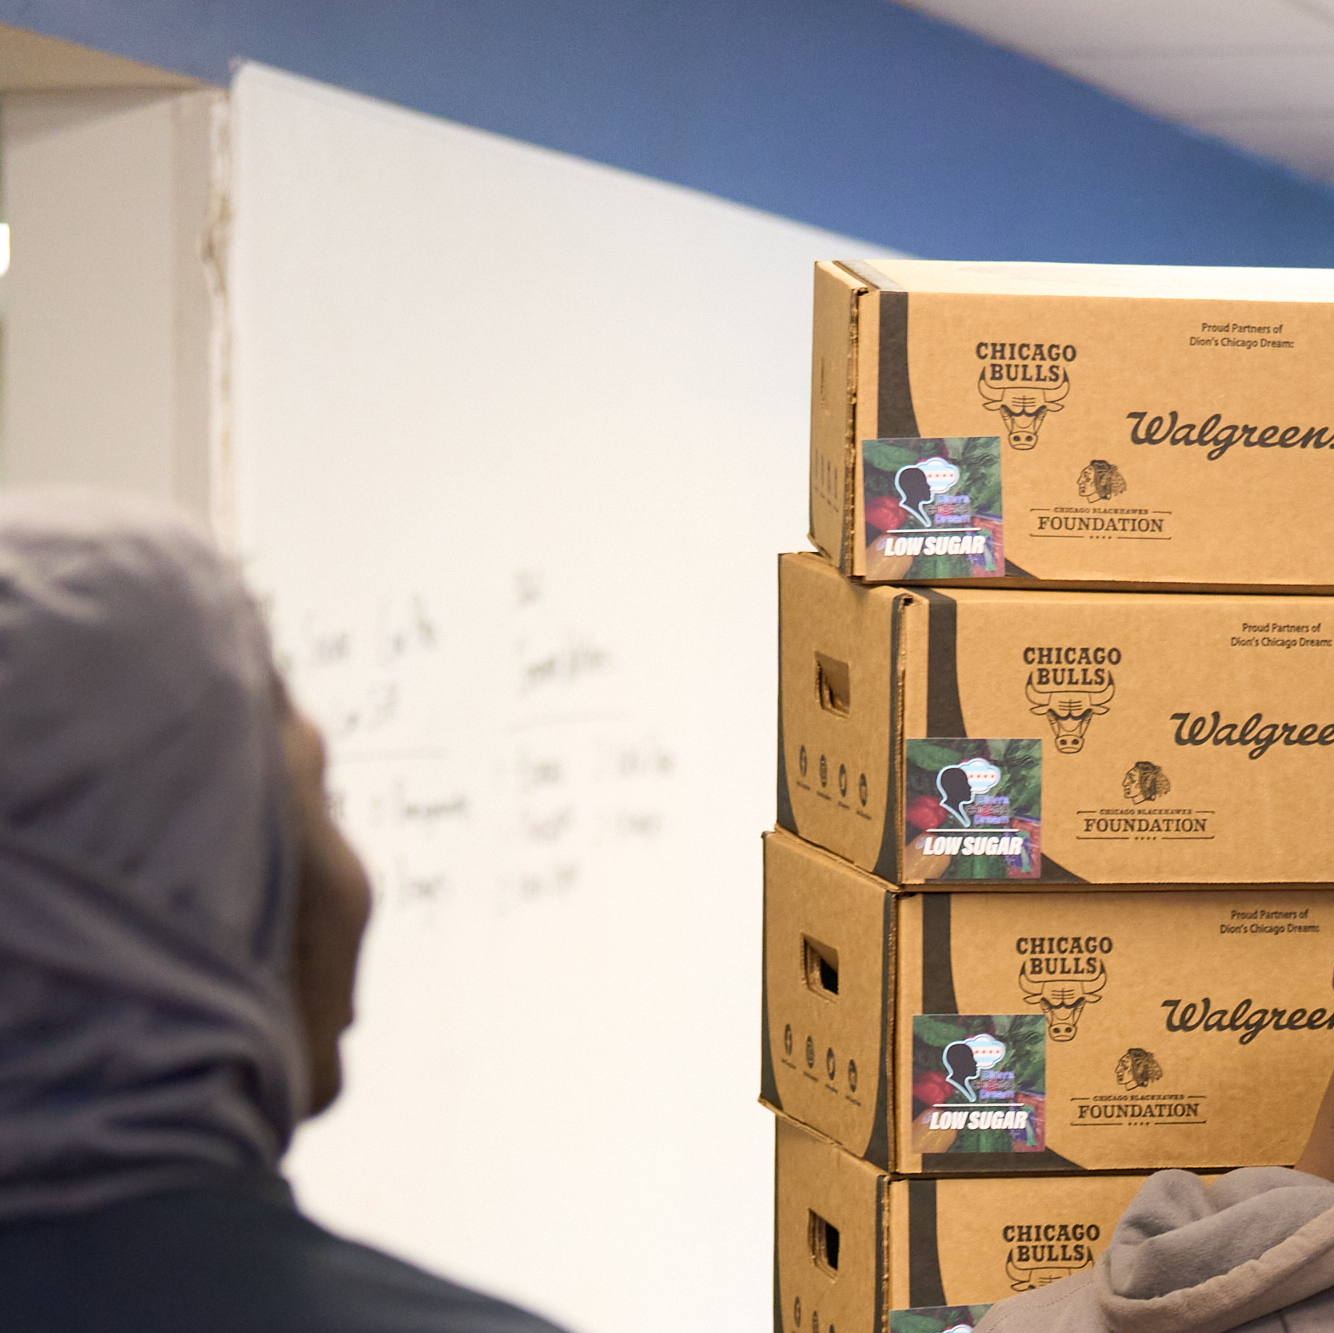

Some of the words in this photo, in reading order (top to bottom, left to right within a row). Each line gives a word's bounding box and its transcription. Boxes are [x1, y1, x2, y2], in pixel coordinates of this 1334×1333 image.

[1201, 322, 1230, 333] Proud
[1231, 322, 1271, 334] Partners
[1272, 323, 1284, 334] of
[975, 341, 1077, 362] CHICAGO
[1220, 337, 1258, 349] Chicago
[1259, 338, 1295, 349] Dream:
[989, 363, 1060, 383] BULLS
[1037, 515, 1165, 532] FOUNDATION
[884, 537, 925, 556] LOW
[923, 536, 986, 556] SUGAR
[1242, 622, 1270, 633] Proud
[1271, 622, 1310, 633] Partners
[1311, 622, 1322, 633] of
[1260, 636, 1297, 649] Chicago
[1023, 646, 1122, 665] CHICAGO
[1036, 667, 1105, 685] BULLS
[1083, 818, 1208, 832] FOUNDATION
[922, 836, 964, 856] LOW
[961, 836, 1025, 856] SUGAR
[1230, 909, 1259, 920] Proud
[1259, 909, 1298, 920] Partners
[1298, 908, 1310, 919] of
[1249, 923, 1286, 935] Chicago
[1016, 936, 1114, 955] CHICAGO
[1029, 957, 1098, 975] BULLS
[1077, 1103, 1200, 1119] FOUNDATION
[929, 1111, 970, 1130] LOW
[967, 1111, 1029, 1130] SUGAR
[1002, 1224, 1100, 1243] CHICAGO
[1016, 1244, 1085, 1262] BULLS
